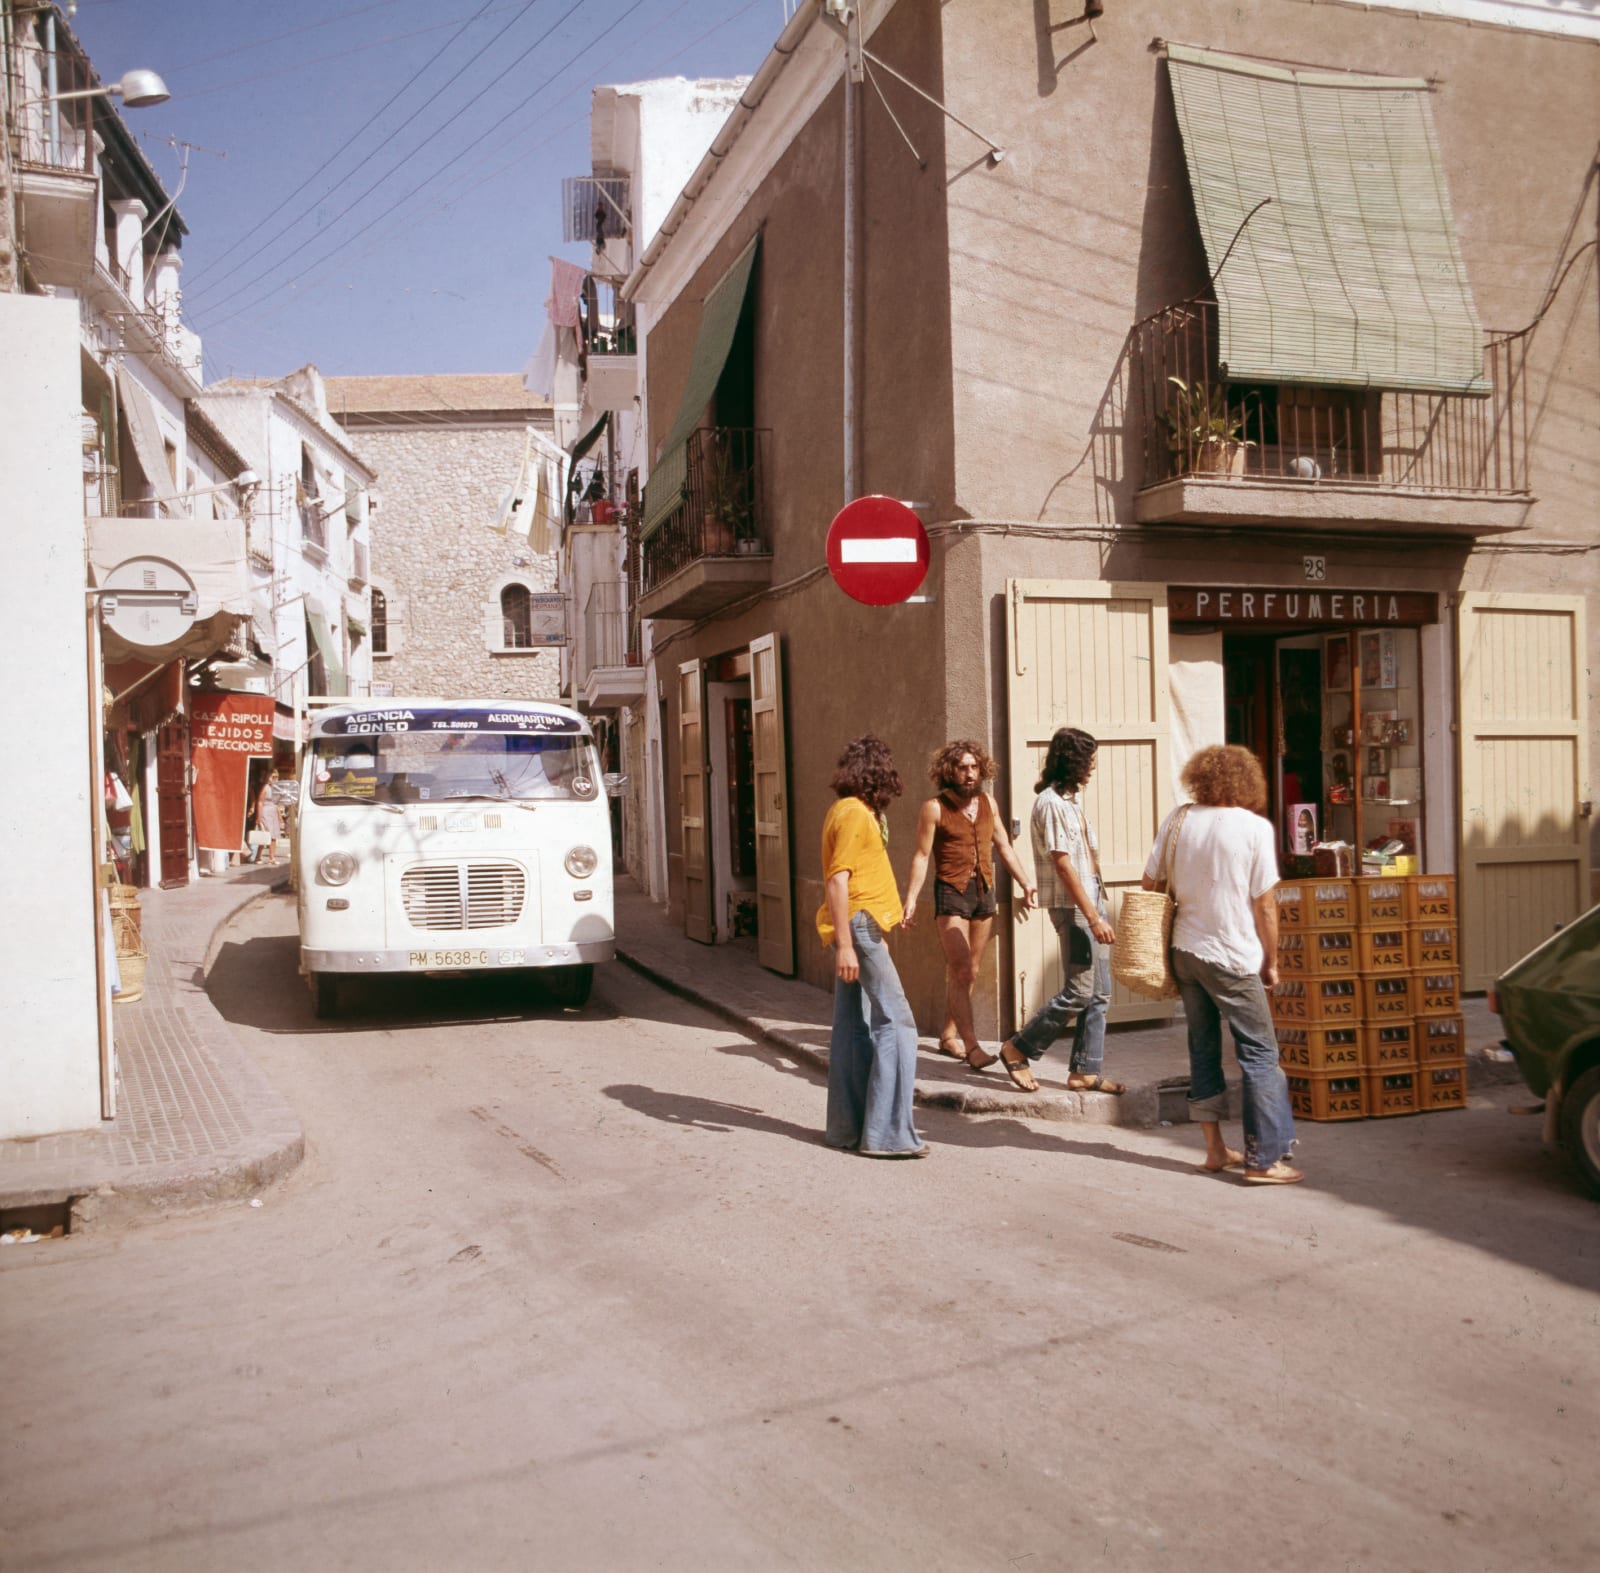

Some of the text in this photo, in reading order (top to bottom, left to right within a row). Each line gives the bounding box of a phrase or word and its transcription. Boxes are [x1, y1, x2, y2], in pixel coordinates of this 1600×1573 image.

[1305, 559, 1325, 579] 28
[1196, 592, 1399, 620] PERFUMERIA
[192, 711, 272, 725] CASA RIPOLL
[345, 710, 416, 725] AGENCIA
[200, 725, 264, 740] TEJIDOS
[347, 721, 409, 733] BONED
[192, 737, 272, 752] CONFECCIONES
[1280, 907, 1300, 922] AS
[1319, 907, 1345, 919] KAS
[1371, 906, 1398, 917] KAS
[1420, 903, 1449, 915] KAS
[1322, 955, 1348, 967] KAS
[1373, 953, 1403, 965] KAS
[1422, 950, 1451, 961] KAS
[1324, 1002, 1352, 1014] KAS
[1378, 1001, 1405, 1012] KAS
[1424, 996, 1454, 1008] KAS
[1275, 1001, 1306, 1016] KAS
[1380, 1048, 1409, 1060] KAS
[1429, 1043, 1456, 1054] KAS
[1326, 1050, 1357, 1063] KAS
[1383, 1095, 1413, 1107] KAS
[1433, 1089, 1461, 1102] KAS
[1292, 1096, 1313, 1113] AS
[1329, 1099, 1360, 1112] KAS
